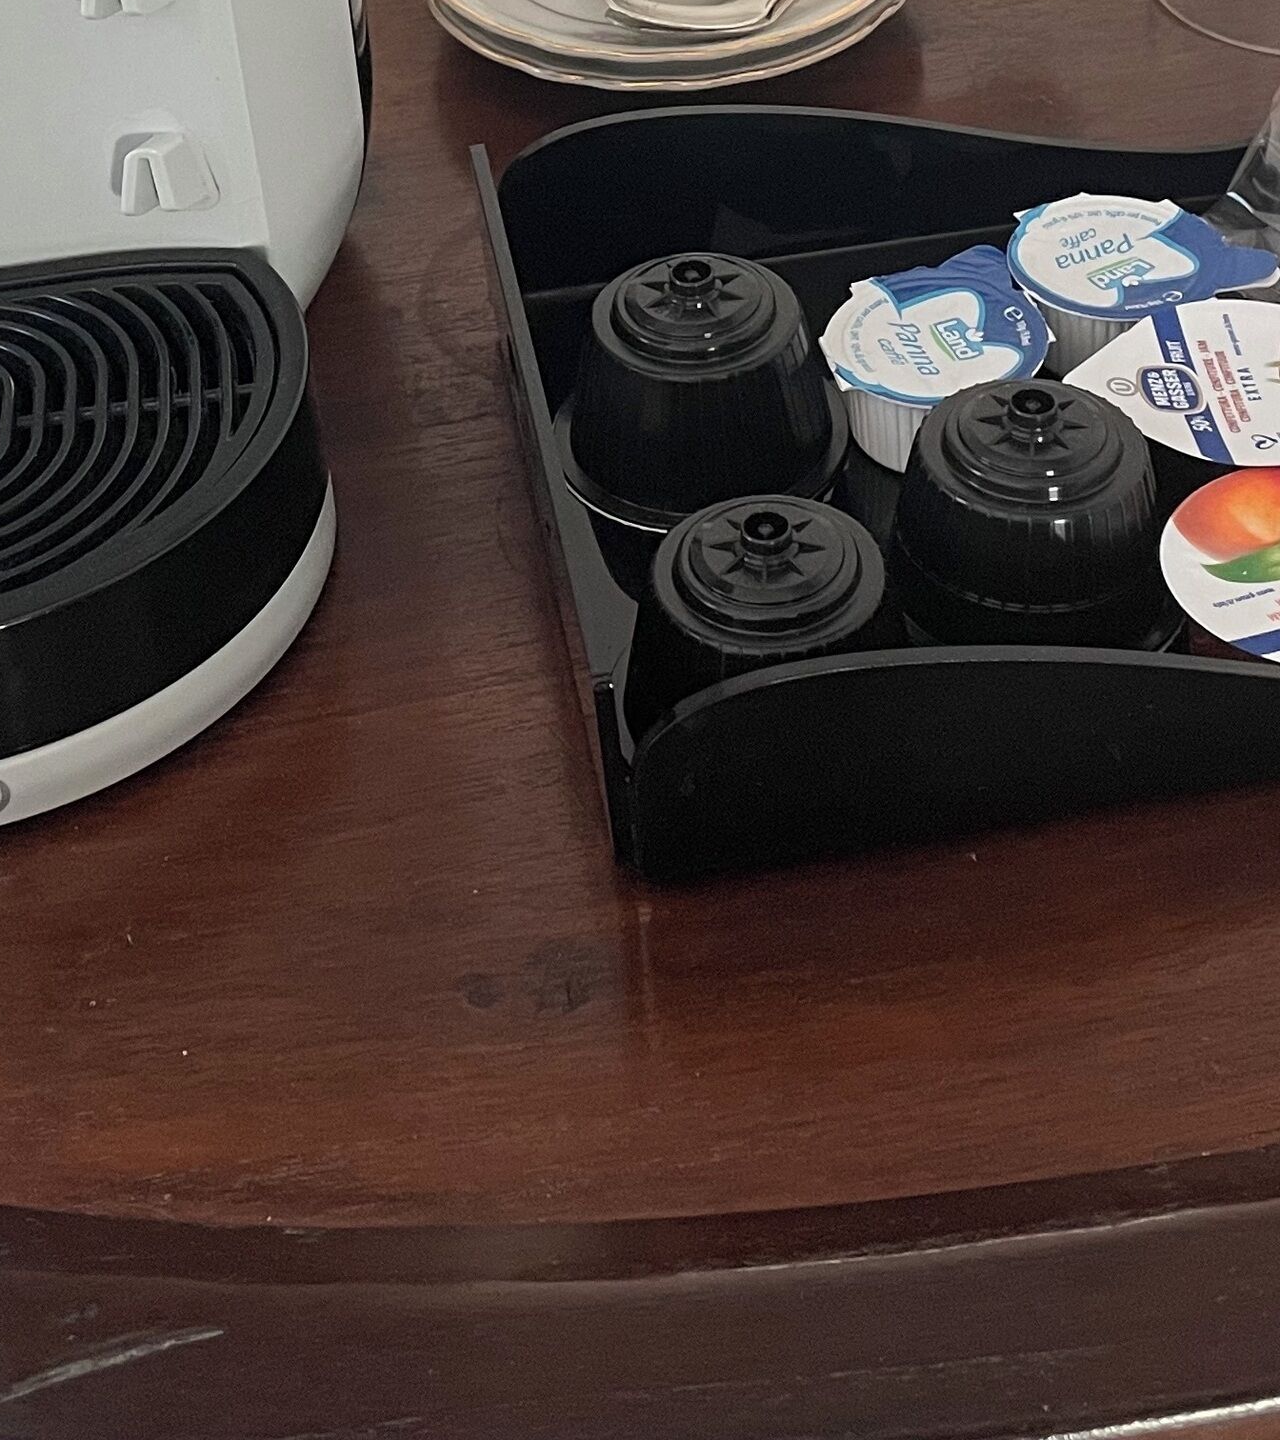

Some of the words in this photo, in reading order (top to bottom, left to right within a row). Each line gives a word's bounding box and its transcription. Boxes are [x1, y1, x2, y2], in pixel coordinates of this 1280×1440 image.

[1055, 233, 1135, 270] Panna
[1094, 259, 1156, 289] Land
[888, 322, 940, 375] Panna
[936, 319, 981, 361] Land
[1161, 368, 1190, 410] GASSER
[1237, 367, 1262, 402] EXTRA
